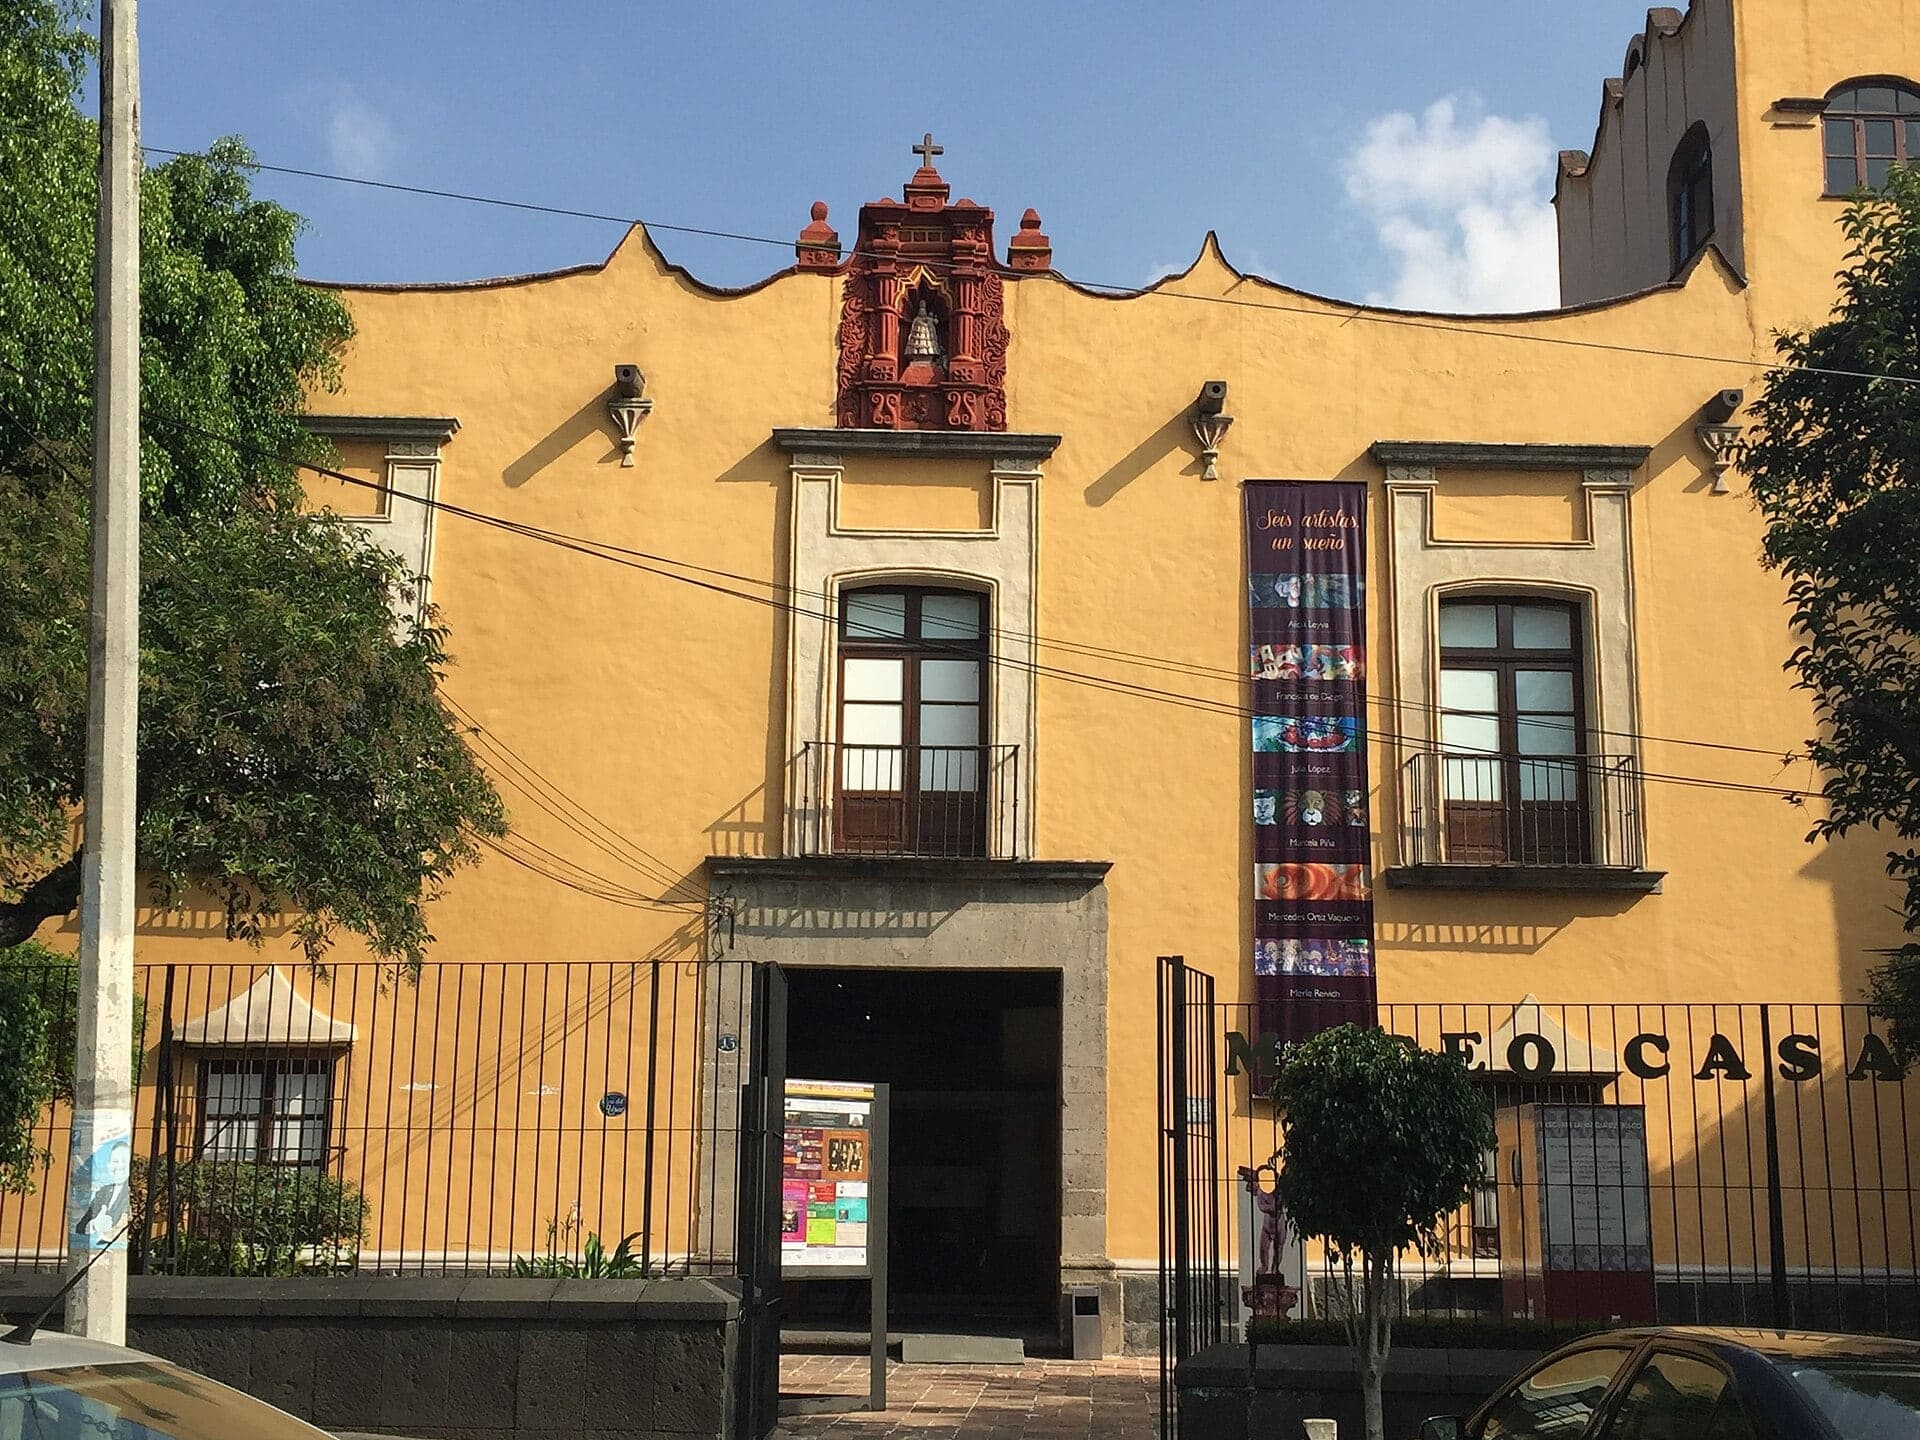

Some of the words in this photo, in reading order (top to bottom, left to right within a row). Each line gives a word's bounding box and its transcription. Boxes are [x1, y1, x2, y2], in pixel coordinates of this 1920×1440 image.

[1256, 508, 1292, 530] Seis
[1271, 538, 1293, 550] un
[1304, 533, 1345, 550] sueño
[1624, 1033, 1906, 1082] CASA
